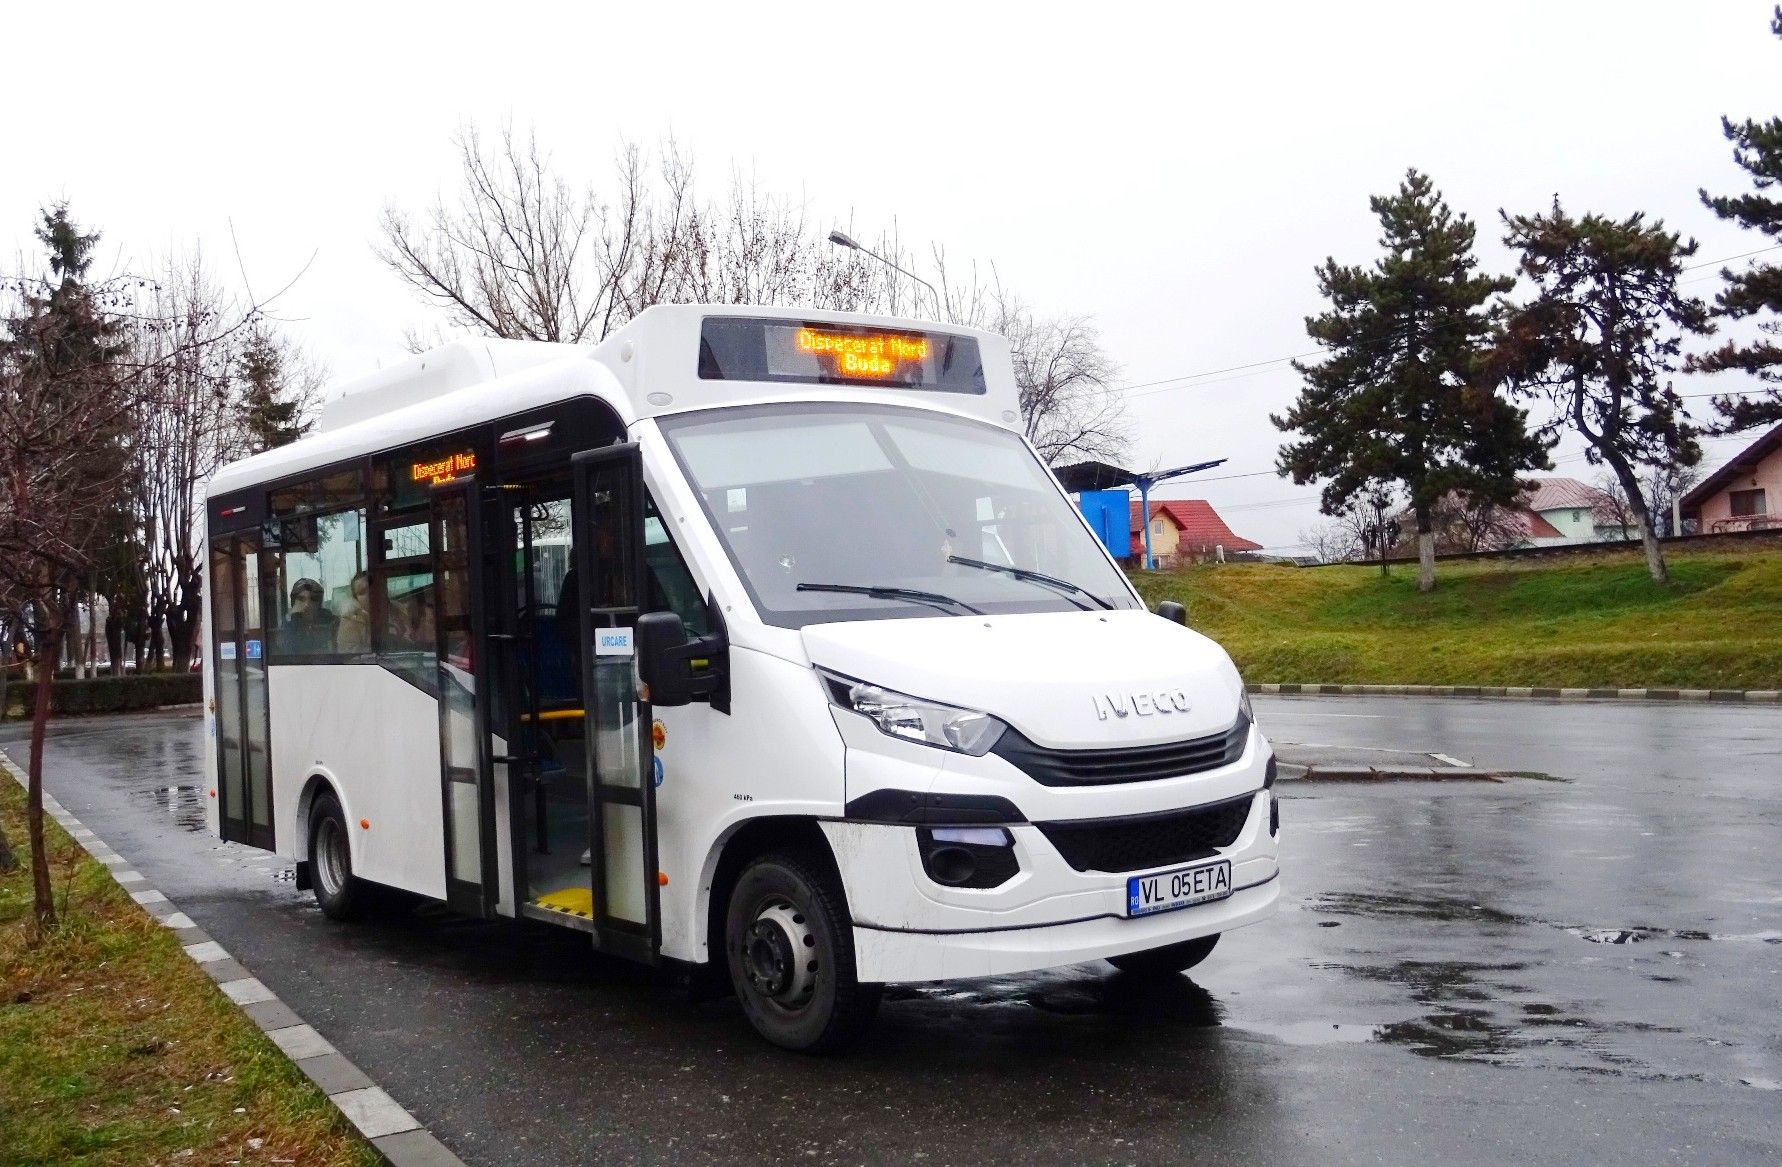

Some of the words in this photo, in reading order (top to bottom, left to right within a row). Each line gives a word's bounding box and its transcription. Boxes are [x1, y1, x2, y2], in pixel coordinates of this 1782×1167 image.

[845, 353, 890, 372] Buda
[601, 636, 627, 647] URCARE
[1092, 687, 1192, 721] IVECO
[1141, 878, 1165, 904] VL
[1130, 896, 1139, 907] RO
